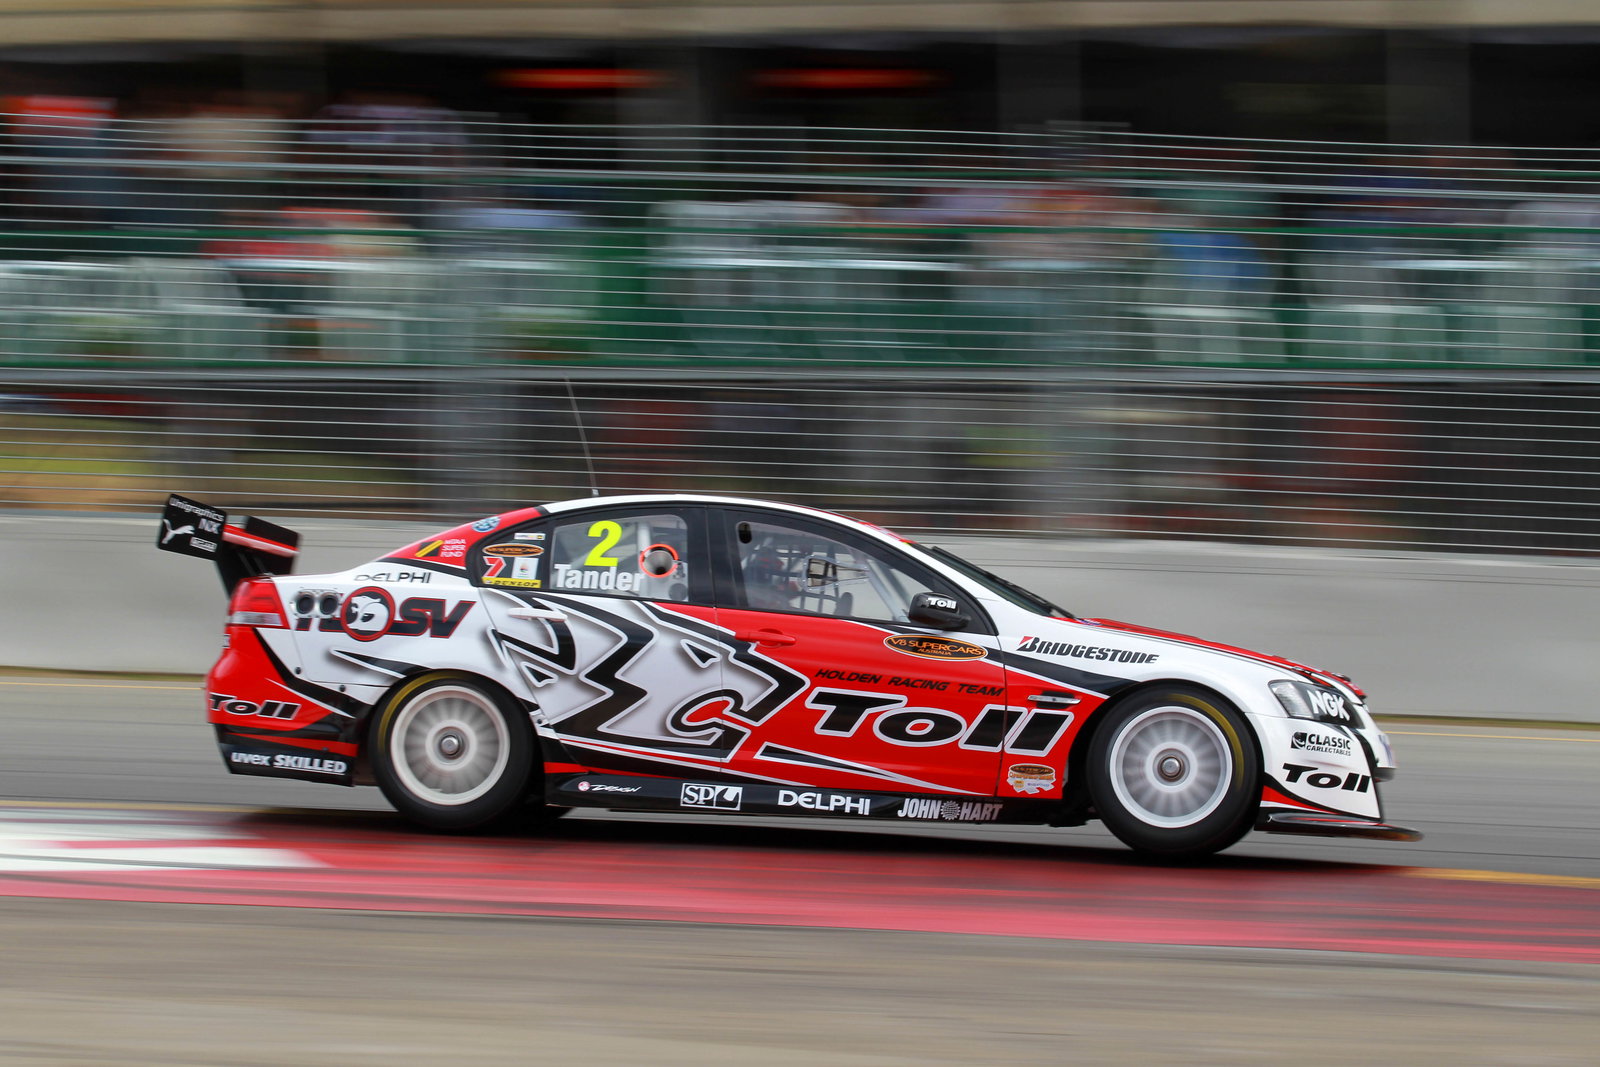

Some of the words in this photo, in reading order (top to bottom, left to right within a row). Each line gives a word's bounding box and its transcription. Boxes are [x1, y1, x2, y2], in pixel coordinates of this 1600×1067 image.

[199, 518, 221, 534] NX
[584, 520, 622, 567] 2
[354, 572, 432, 584] DELPHI
[482, 556, 506, 578] 7
[554, 563, 645, 592] Tander
[927, 597, 957, 609] Toll
[891, 637, 907, 647] V8
[908, 640, 983, 656] SUPERCARS
[918, 647, 953, 656] AUSTRALIA
[1016, 636, 1160, 664] BRIDGESTONE
[815, 669, 882, 684] HOLDEN
[888, 676, 950, 691] RACING
[958, 683, 1005, 697] TEAM
[209, 692, 301, 720] Toll
[1307, 690, 1350, 721] NGK
[804, 687, 1075, 757] Toll
[1308, 733, 1351, 750] CLASSIC
[231, 752, 272, 767] uvex
[273, 755, 347, 774] SKILLED
[1282, 763, 1371, 793] Toll
[777, 790, 871, 815] DELPHI
[897, 798, 942, 820] JOHN
[958, 802, 1003, 821] HART
